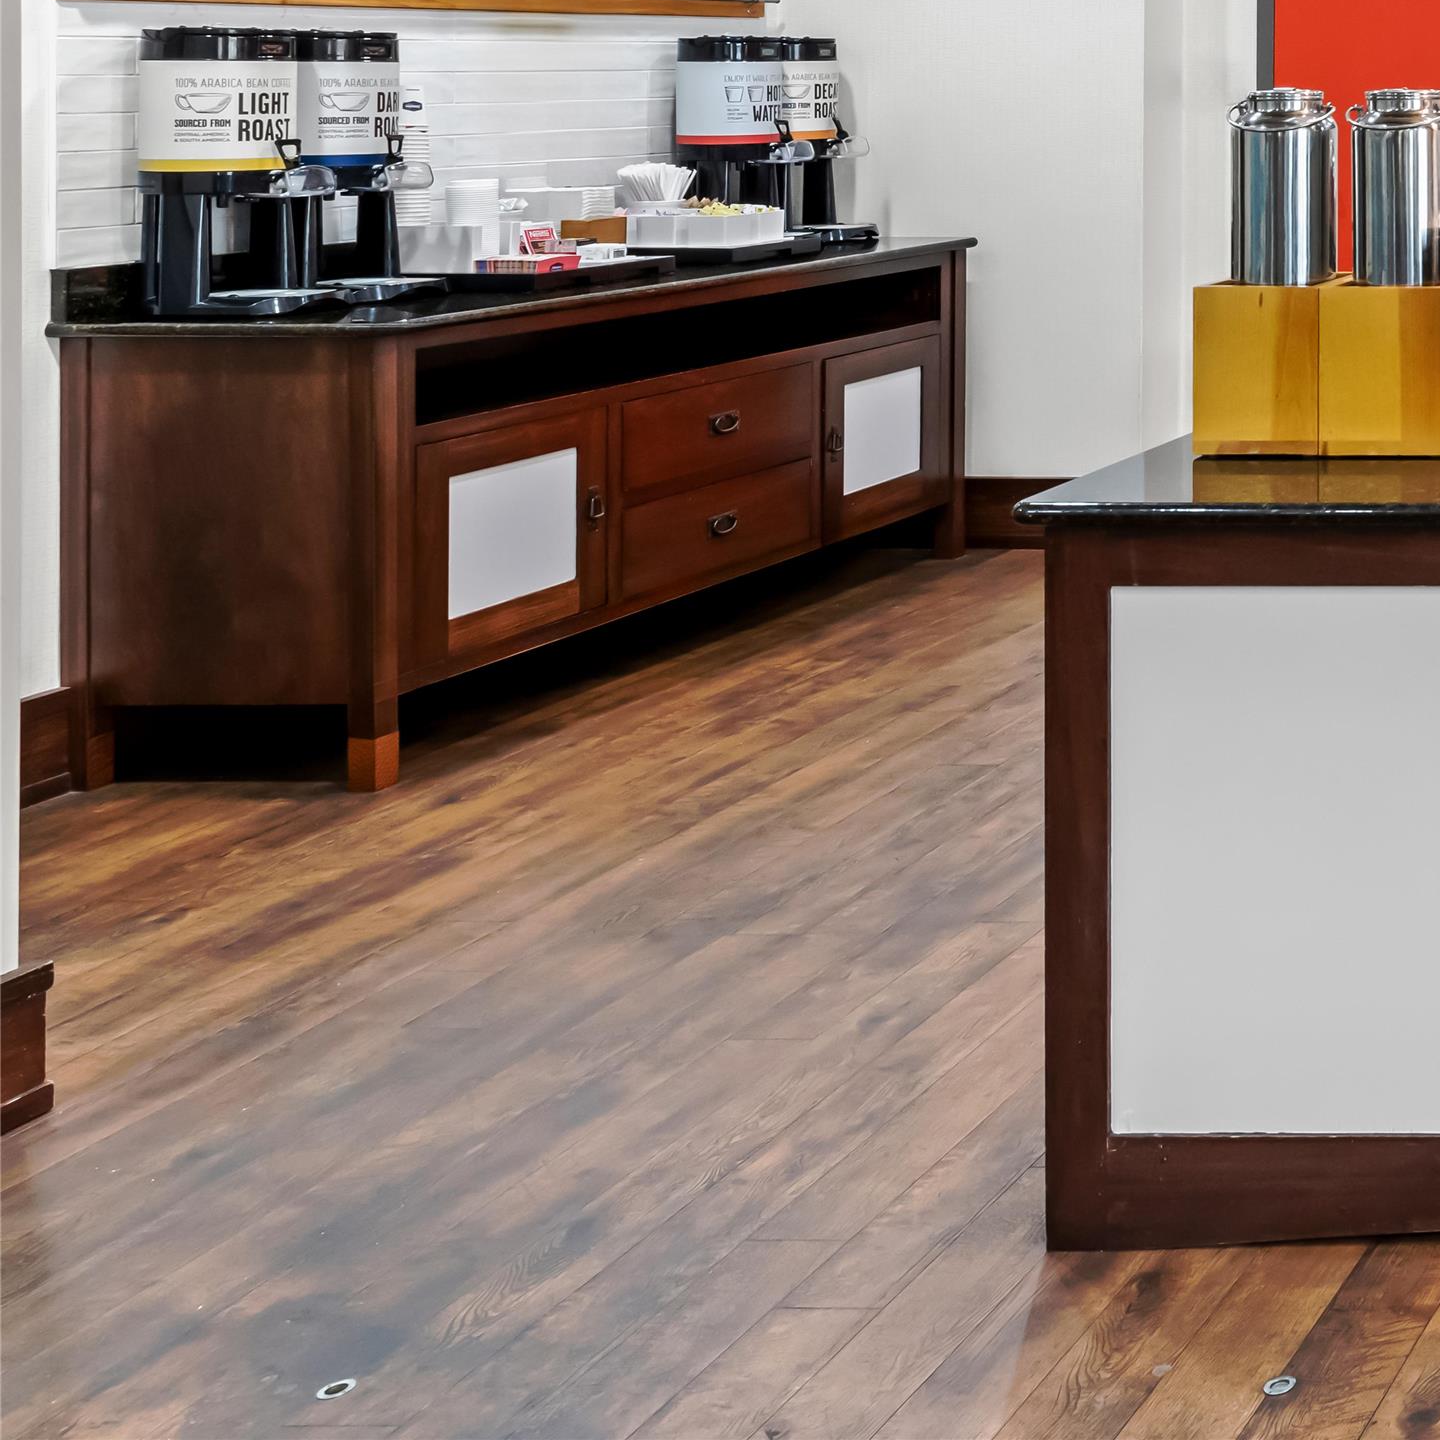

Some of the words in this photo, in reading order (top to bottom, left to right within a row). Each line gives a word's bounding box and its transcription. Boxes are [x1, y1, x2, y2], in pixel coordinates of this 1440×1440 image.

[175, 78, 198, 88] 100%
[200, 78, 242, 88] ARABICA
[246, 78, 269, 88] BEAN
[344, 78, 378, 87] ARABICA
[238, 92, 289, 115] LIGHT
[174, 119, 207, 127] SOURCED
[210, 119, 231, 127] FROM
[238, 118, 290, 141] ROAST
